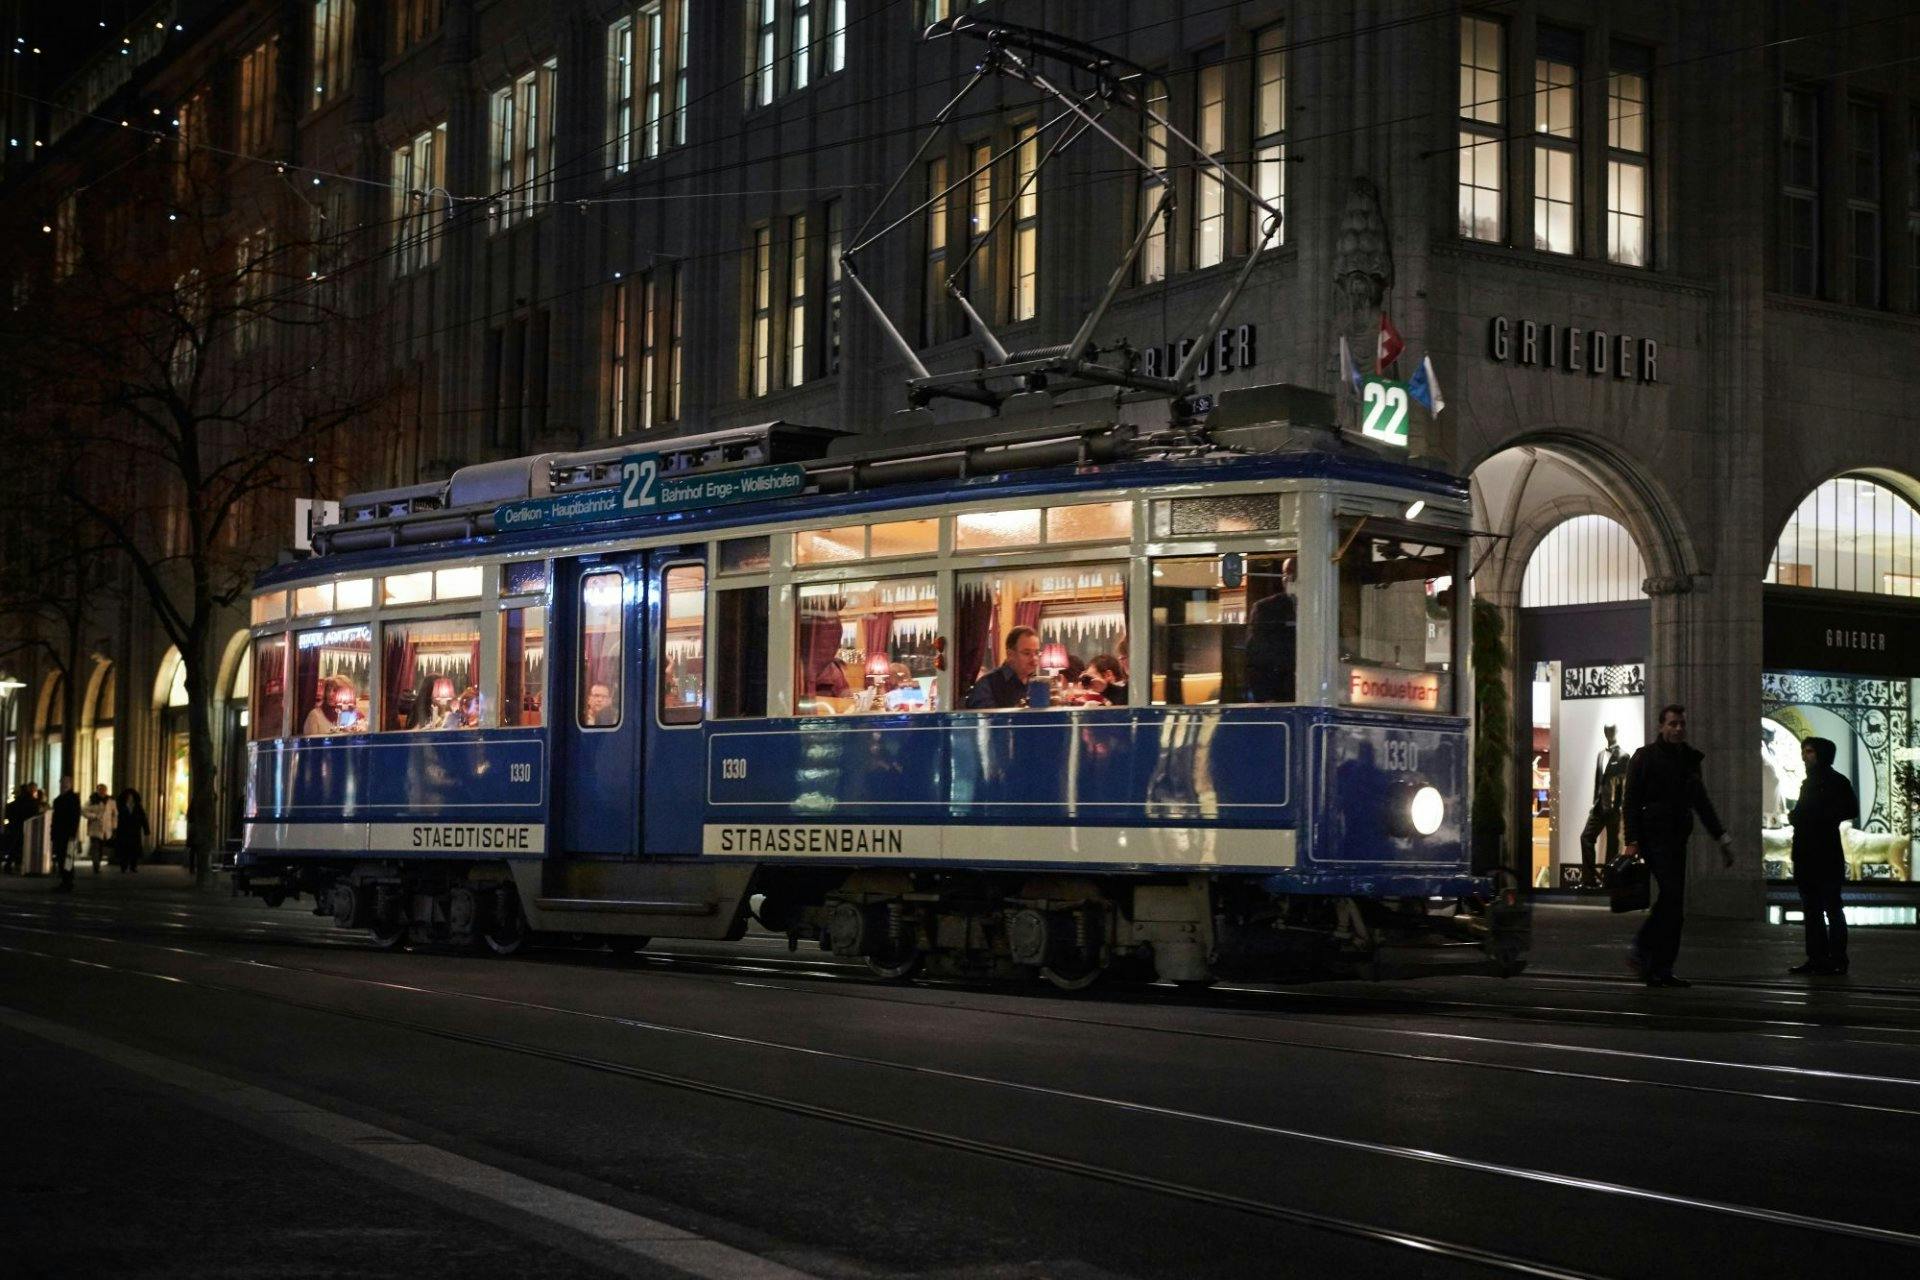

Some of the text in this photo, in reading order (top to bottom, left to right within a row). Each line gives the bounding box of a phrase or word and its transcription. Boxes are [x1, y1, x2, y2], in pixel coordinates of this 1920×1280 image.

[1144, 324, 1254, 378] RIEDER
[1492, 316, 1657, 382] GRIEDER
[1362, 381, 1409, 447] 22
[623, 460, 656, 509] 22
[661, 484, 703, 503] Bahnhof
[706, 482, 733, 498] Enge
[741, 474, 800, 493] Wollishofen
[505, 507, 542, 523] Oerlikon
[552, 497, 617, 518] Hauptbahnhof
[1826, 628, 1886, 651] GRIEDER
[722, 758, 747, 779] 1330
[1383, 740, 1419, 773] 1330
[510, 763, 531, 782] 1330
[413, 827, 529, 848] STAEDTISCHE
[722, 829, 902, 853] STRASSENBAHN
